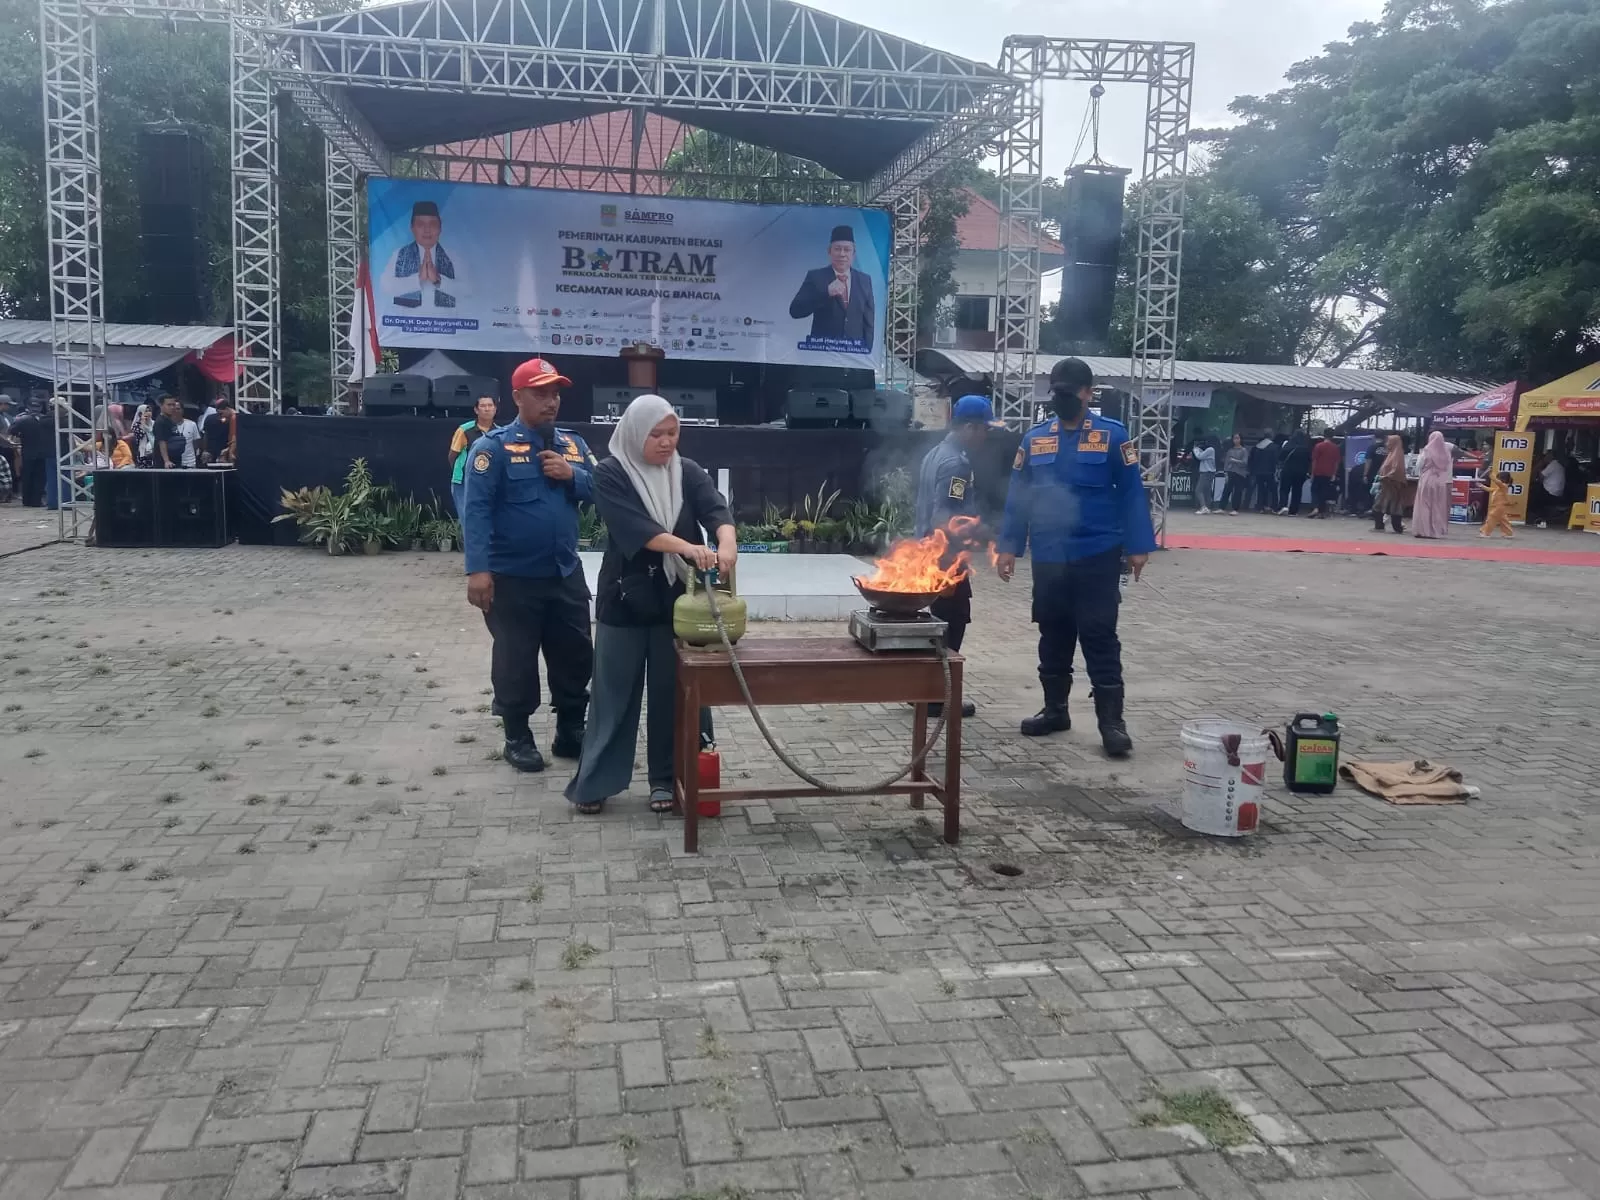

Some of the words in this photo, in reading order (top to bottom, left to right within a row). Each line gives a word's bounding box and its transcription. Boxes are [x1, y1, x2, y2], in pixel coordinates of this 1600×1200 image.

[624, 208, 674, 221] SAMPRO
[558, 230, 624, 243] PEMERINTAH
[626, 234, 686, 247] KABUPATEN
[687, 238, 723, 249] BEKASI
[561, 246, 717, 277] BTRAM
[562, 270, 638, 281] BERKOLABORASI
[640, 274, 669, 283] TERUS
[669, 275, 716, 284] MELAYANI
[556, 283, 624, 297] KECAMATAN
[626, 287, 671, 299] KARANG
[672, 291, 721, 301] BAHAGIA
[1171, 476, 1191, 492] PESTA
